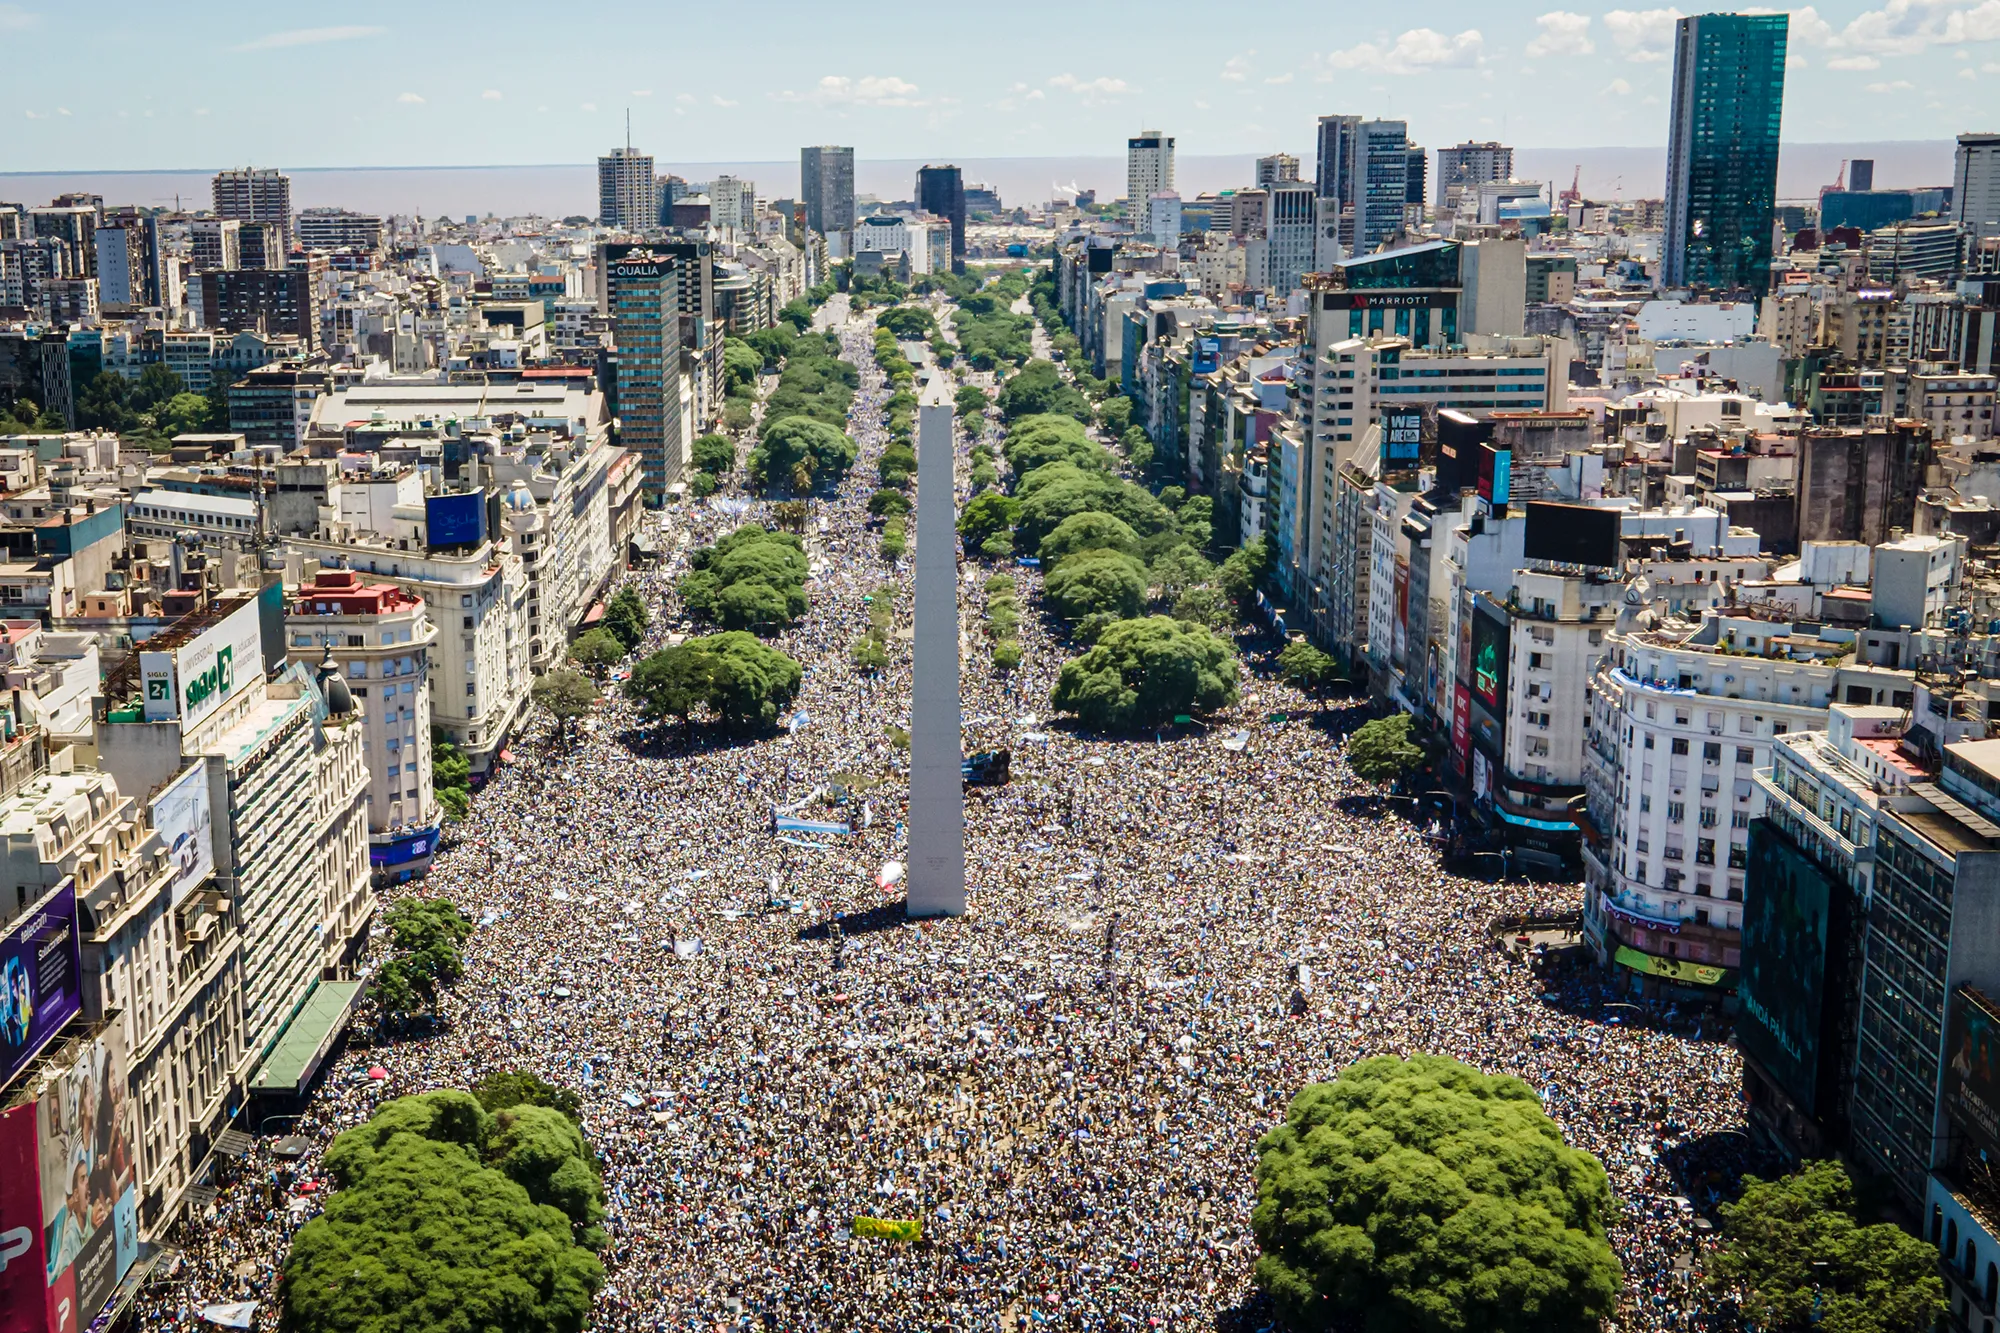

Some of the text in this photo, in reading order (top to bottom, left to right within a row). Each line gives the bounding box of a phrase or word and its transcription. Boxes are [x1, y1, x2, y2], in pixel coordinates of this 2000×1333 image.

[617, 266, 659, 276] QUALIA
[1369, 296, 1428, 305] MARRIOTT
[1390, 429, 1404, 443] ARE
[1391, 415, 1420, 428] WE
[184, 643, 214, 673] UNIVERSIDAD
[151, 684, 167, 700] 21
[185, 664, 218, 711] SIGLO
[21, 912, 47, 944] telecom
[38, 924, 70, 961] Soluciones IoT
[1747, 995, 1769, 1029] ANDÁ
[80, 1230, 114, 1282] Delivery Oficial
